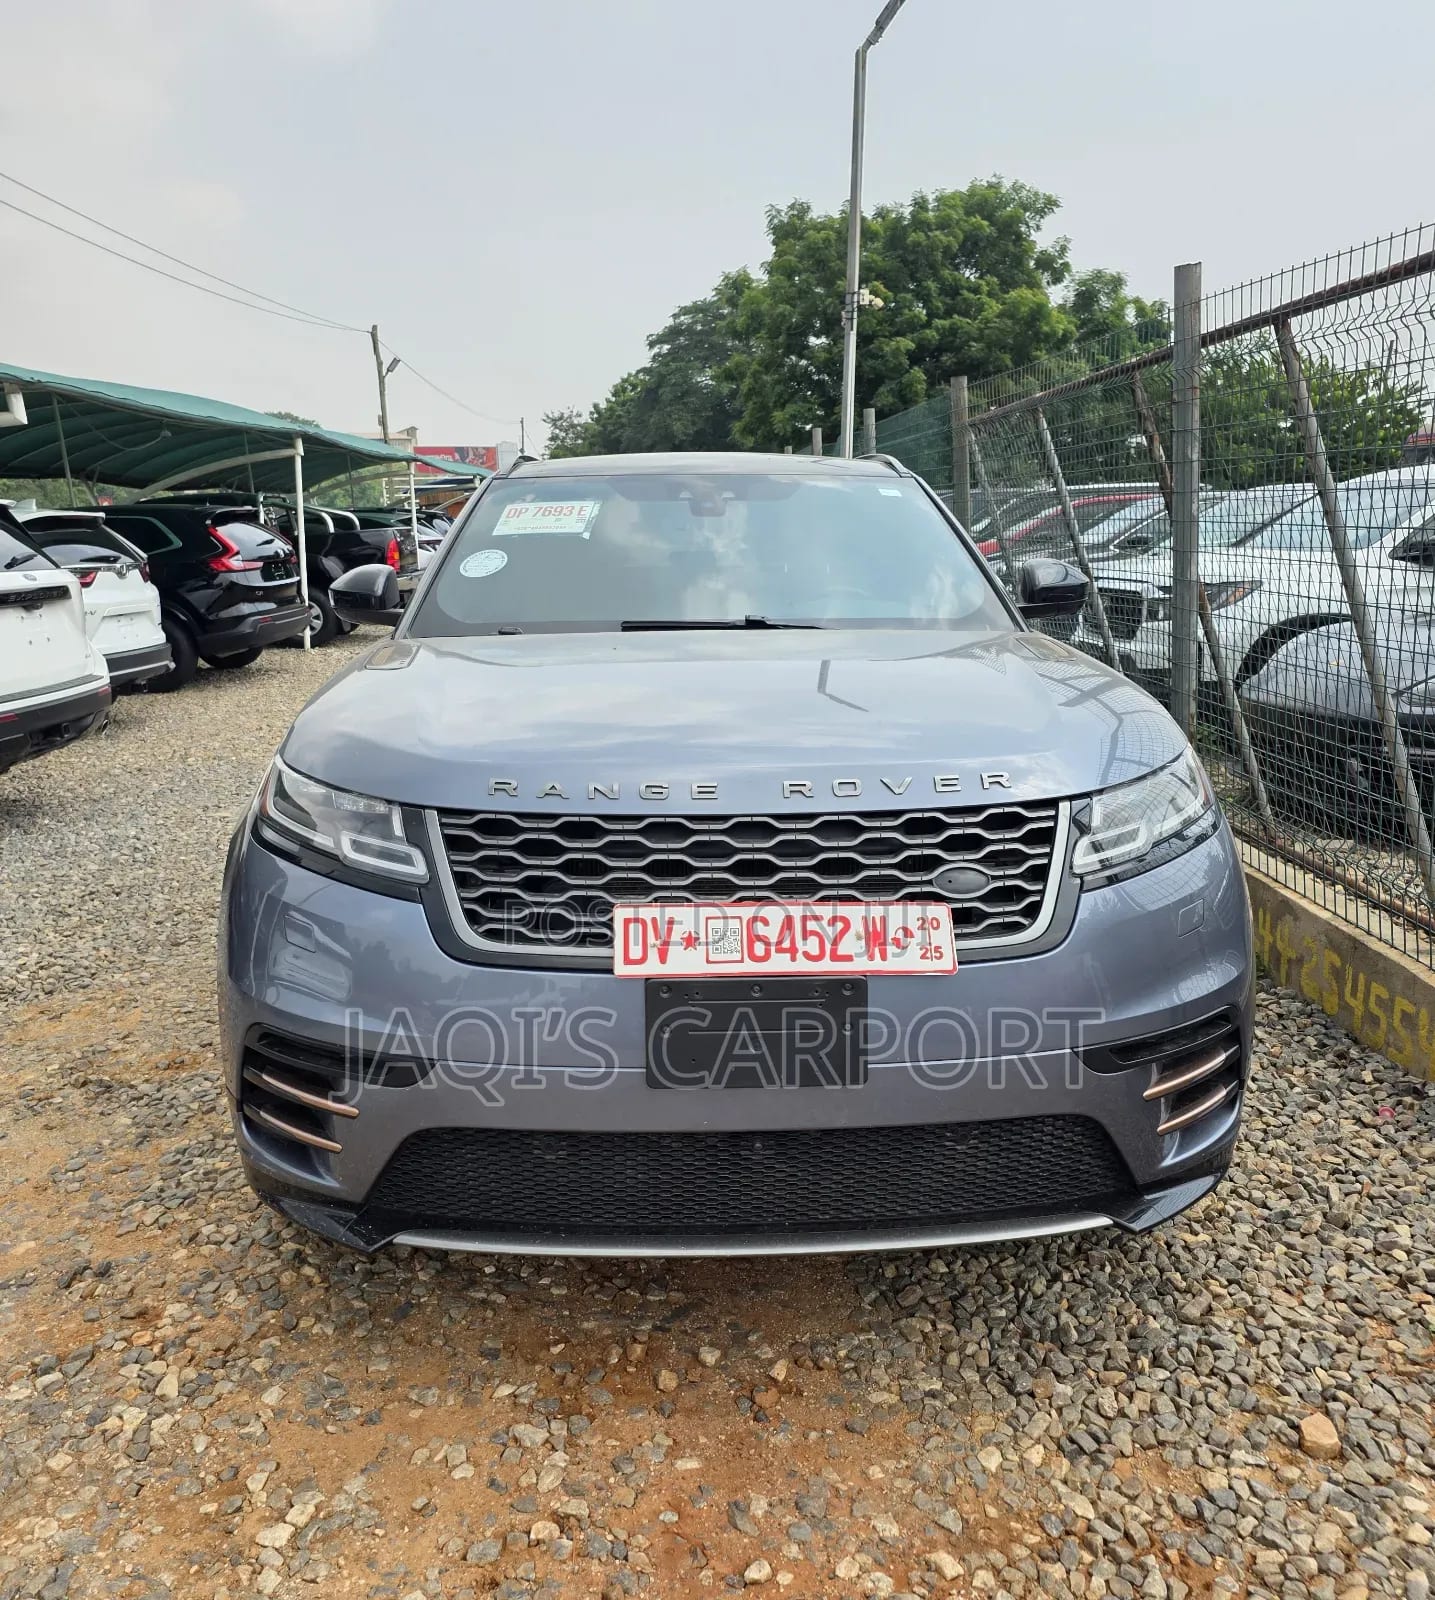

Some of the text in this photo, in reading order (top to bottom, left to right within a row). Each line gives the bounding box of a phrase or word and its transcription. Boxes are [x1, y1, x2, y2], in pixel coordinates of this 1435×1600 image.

[532, 505, 575, 518] 7693
[488, 771, 1013, 800] RANGE ROVER
[916, 916, 941, 931] 20
[622, 914, 888, 966] DV 6452 W
[918, 945, 944, 961] 25
